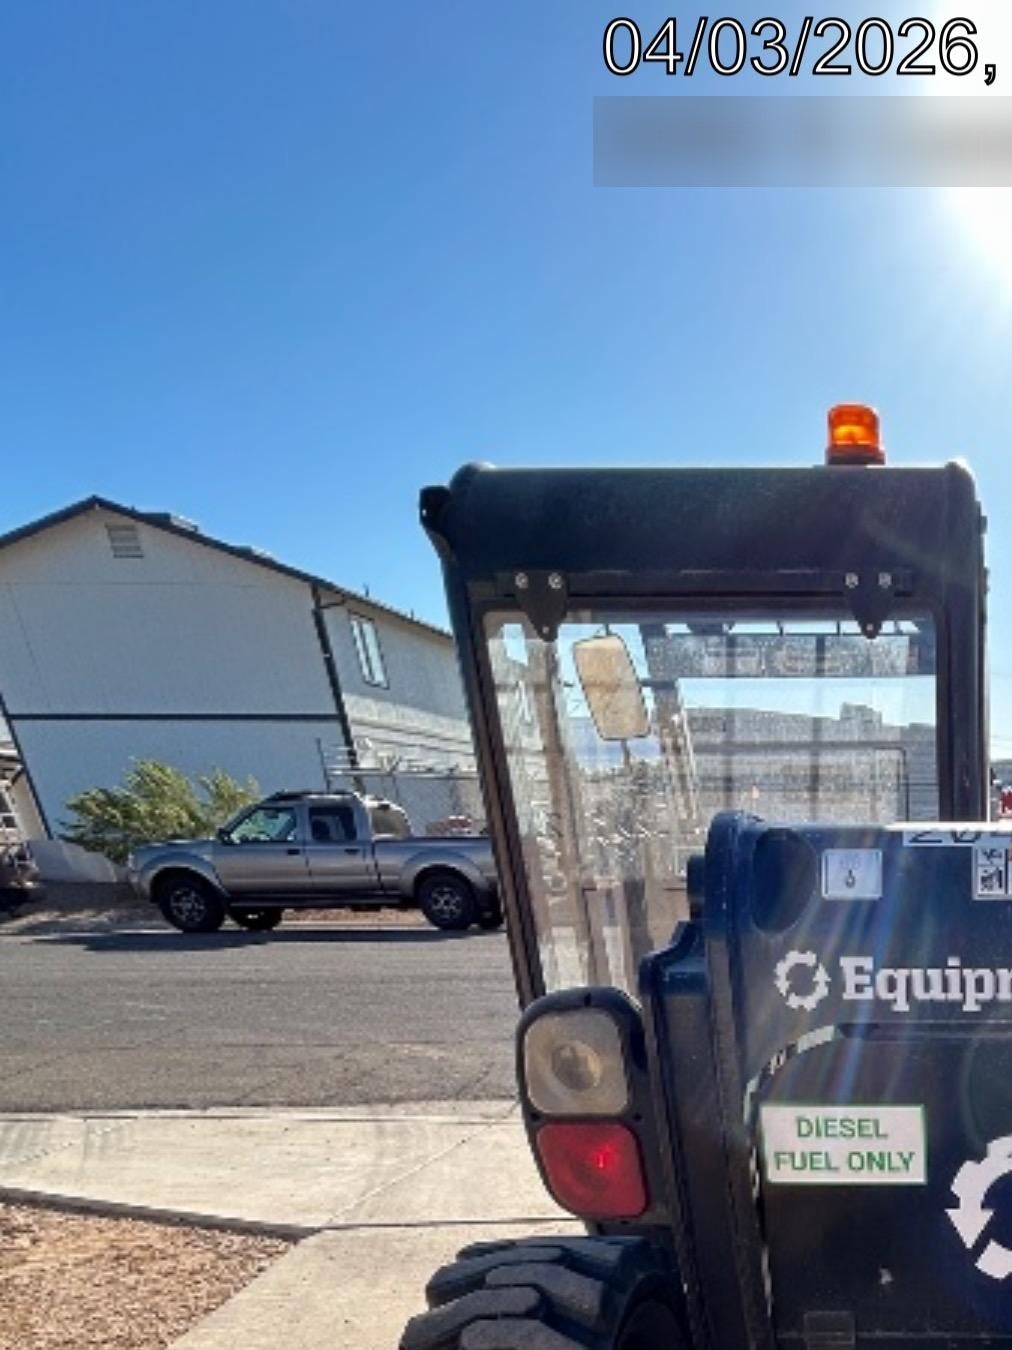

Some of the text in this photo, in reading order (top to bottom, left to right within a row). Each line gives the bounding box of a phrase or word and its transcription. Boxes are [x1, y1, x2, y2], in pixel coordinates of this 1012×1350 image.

[797, 1117, 888, 1138] DIESEL
[774, 1151, 915, 1172] FUEL ONLY
